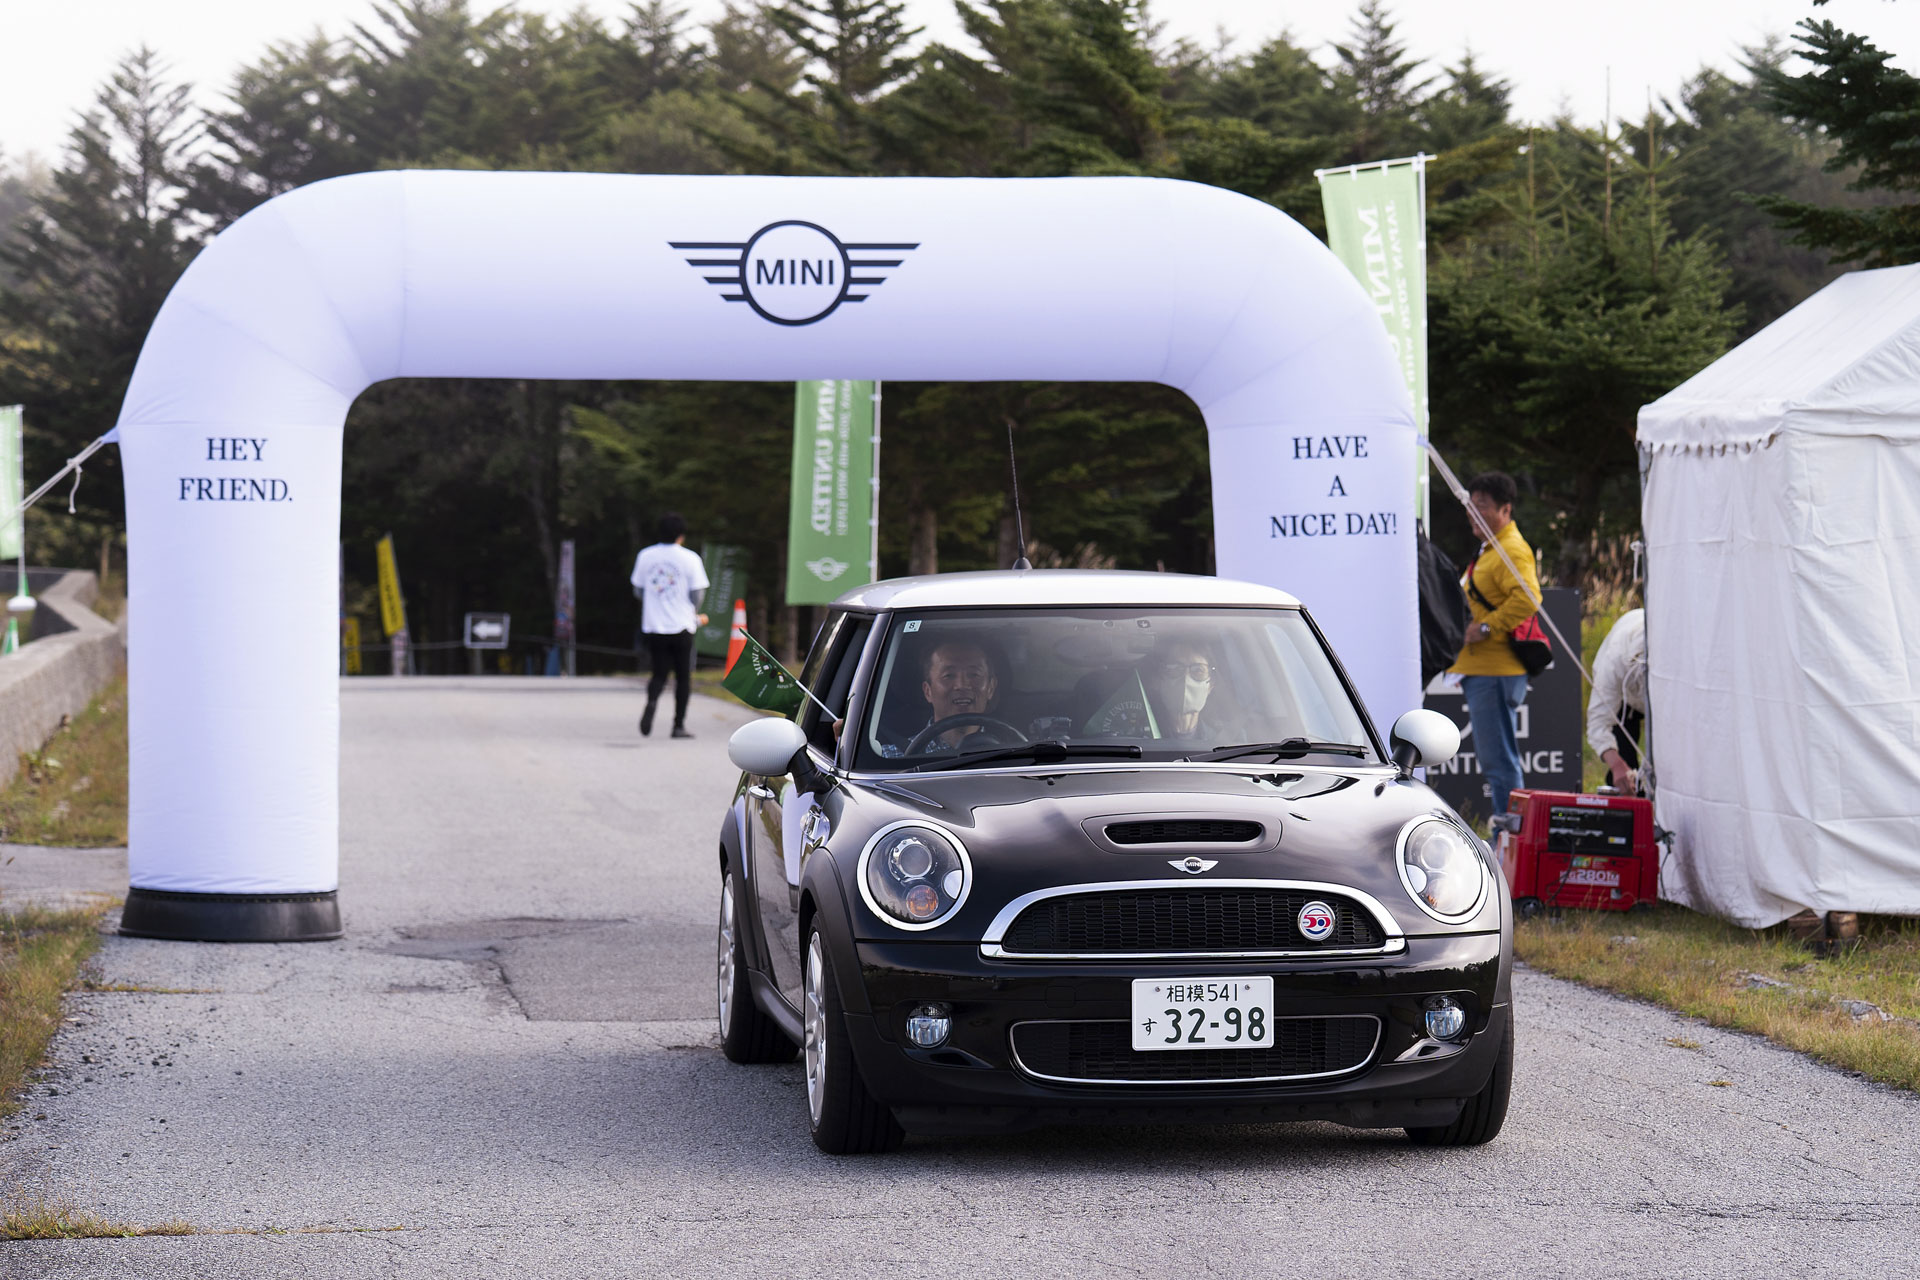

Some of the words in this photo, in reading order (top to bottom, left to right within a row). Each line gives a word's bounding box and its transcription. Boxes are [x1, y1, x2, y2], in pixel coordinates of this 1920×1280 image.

[756, 259, 834, 285] MINI
[206, 438, 268, 461] HEY
[1293, 436, 1369, 459] HAVE
[178, 478, 293, 502] FRIEND.
[1328, 475, 1347, 497] A
[1270, 514, 1337, 538] NICE
[1345, 512, 1398, 535] DAY!
[752, 652, 765, 676] MINI
[1426, 751, 1564, 775] ENTNCE
[1141, 1017, 1158, 1036] す
[1163, 1006, 1266, 1044] 32-98
